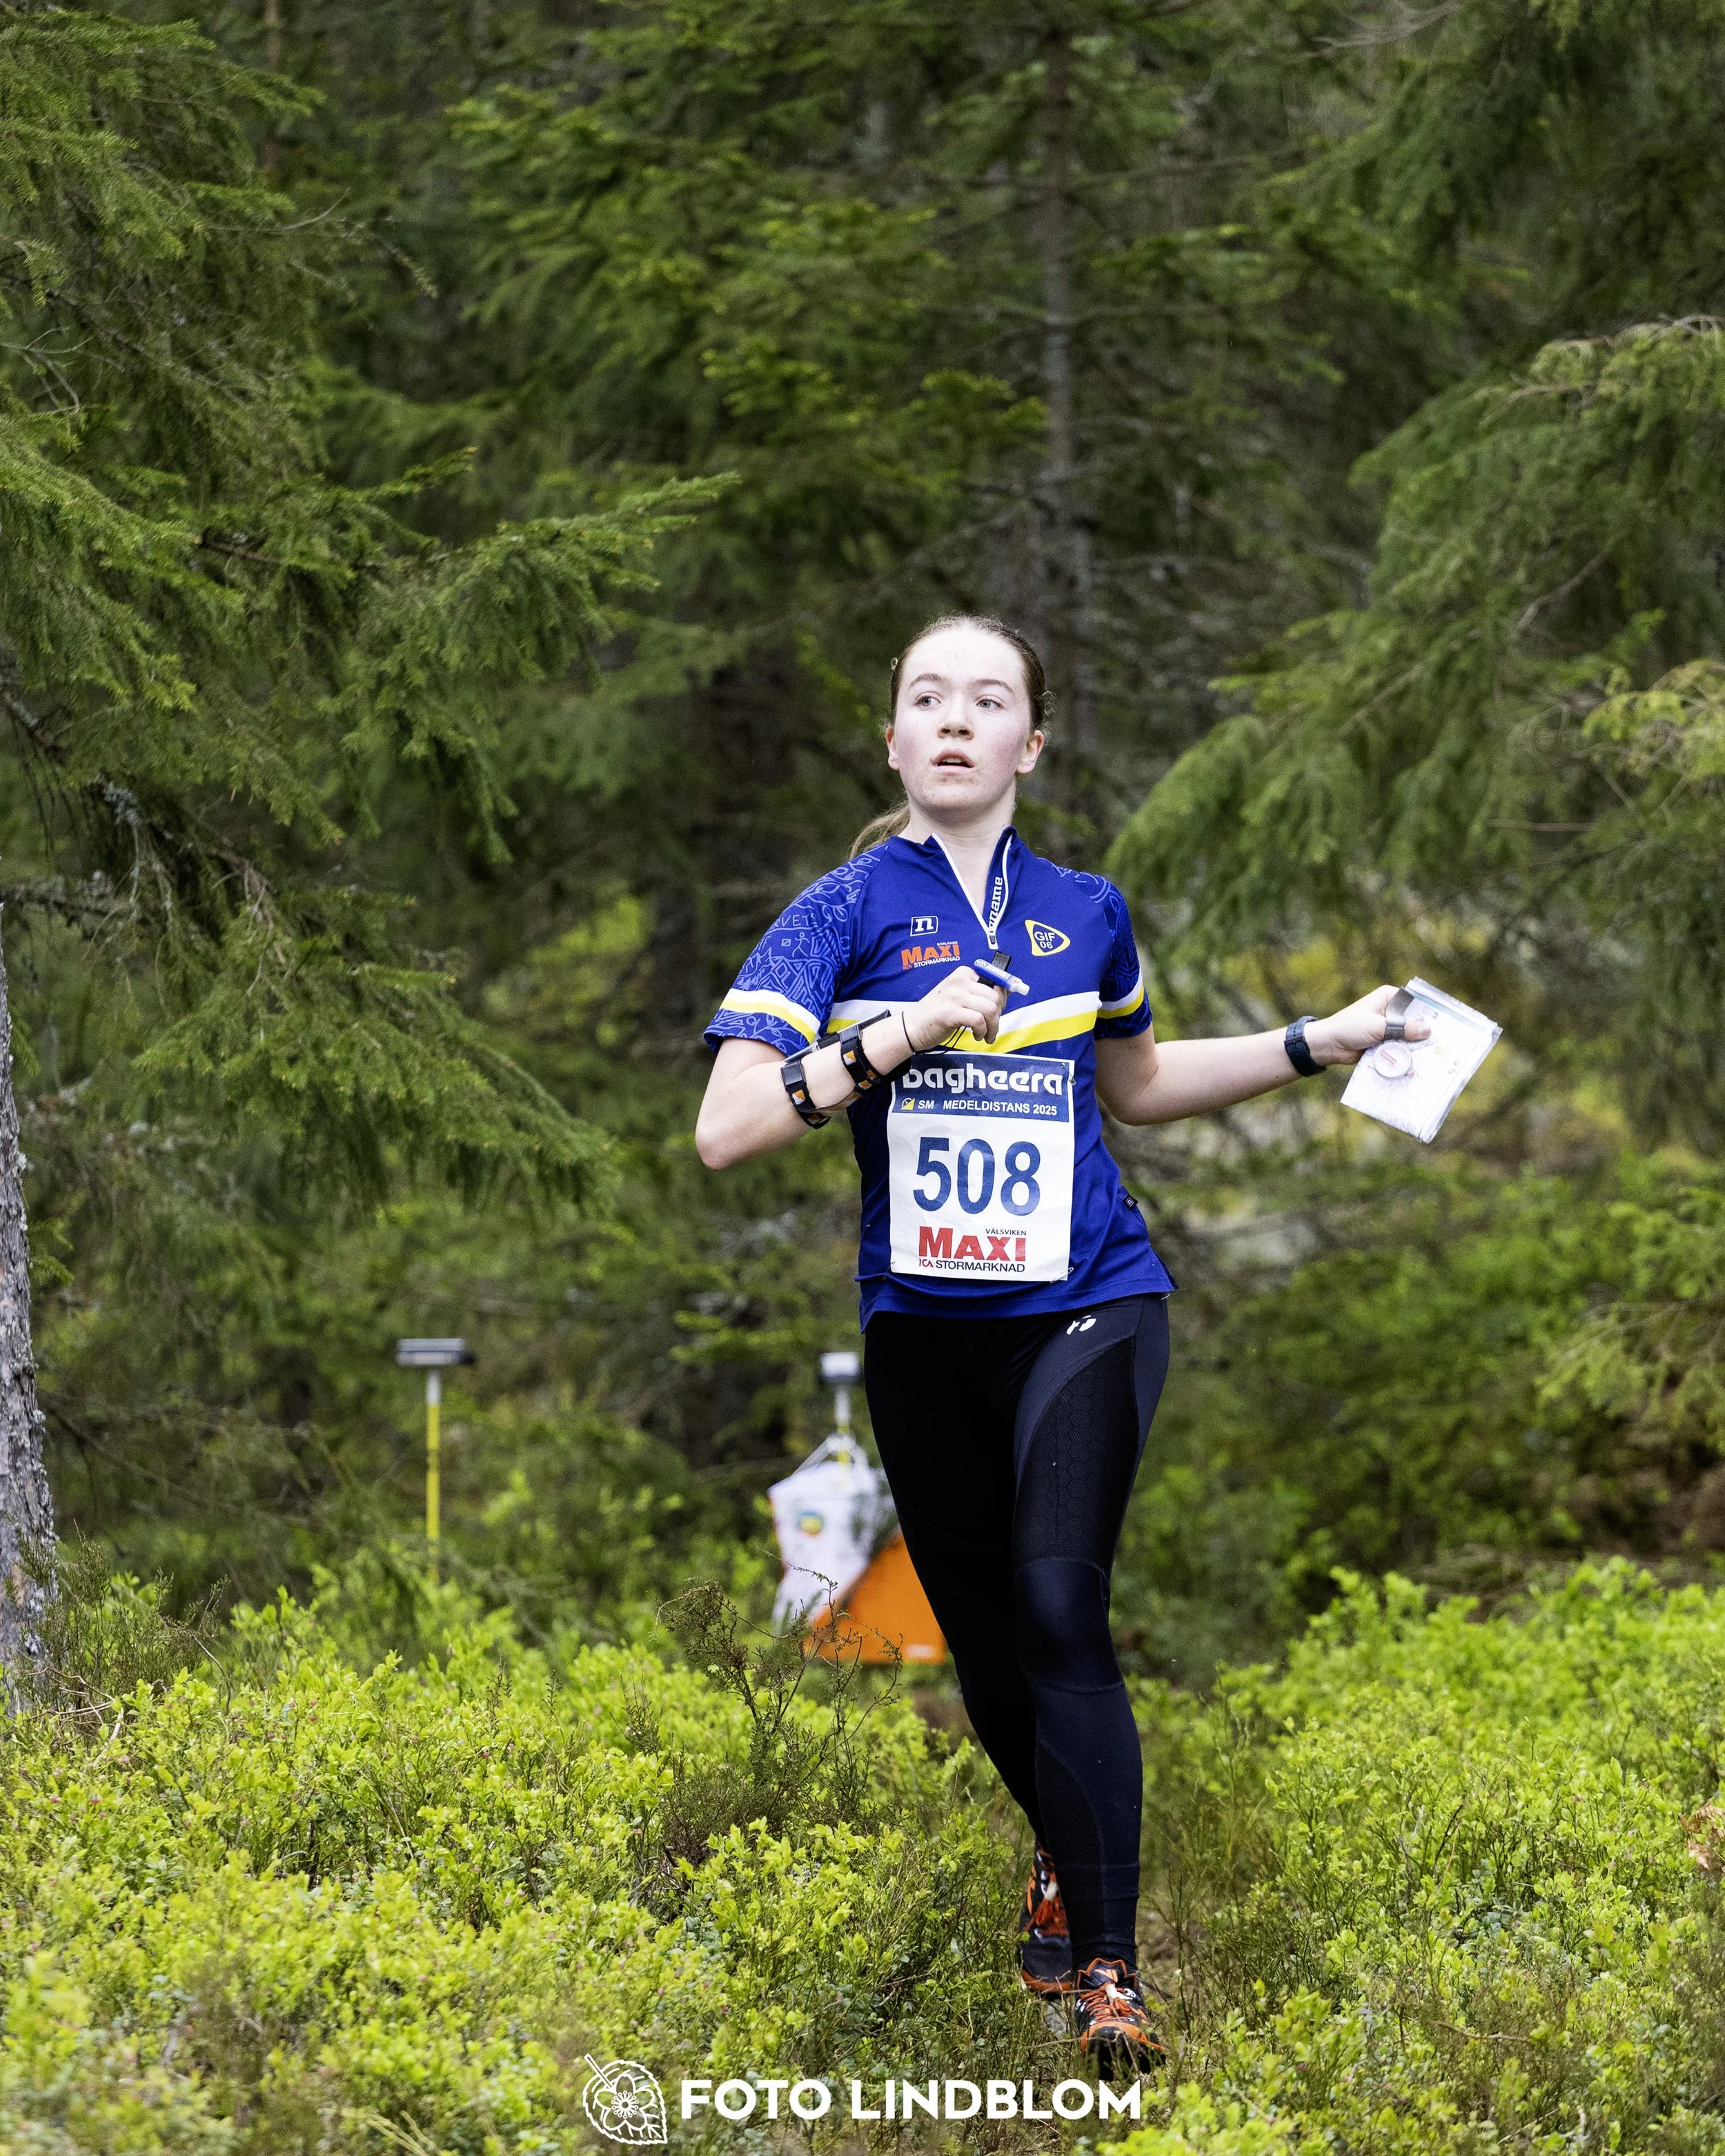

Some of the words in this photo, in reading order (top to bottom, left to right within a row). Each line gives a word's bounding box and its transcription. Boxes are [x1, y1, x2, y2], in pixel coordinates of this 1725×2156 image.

[1034, 931, 1056, 942] GIF
[901, 944, 960, 966] MAXI
[914, 956, 960, 968] STORMARKNAD
[918, 1100, 934, 1109] SM
[943, 1100, 1030, 1113] MEDELDISTANS
[1033, 1104, 1057, 1116] 2025
[913, 1136, 1041, 1216] 508
[985, 1227, 1027, 1236] VÄLSVIKEN
[918, 1226, 1026, 1261] MAXI
[919, 1258, 933, 1267] ICA
[936, 1260, 1025, 1272] STORMARKNAD
